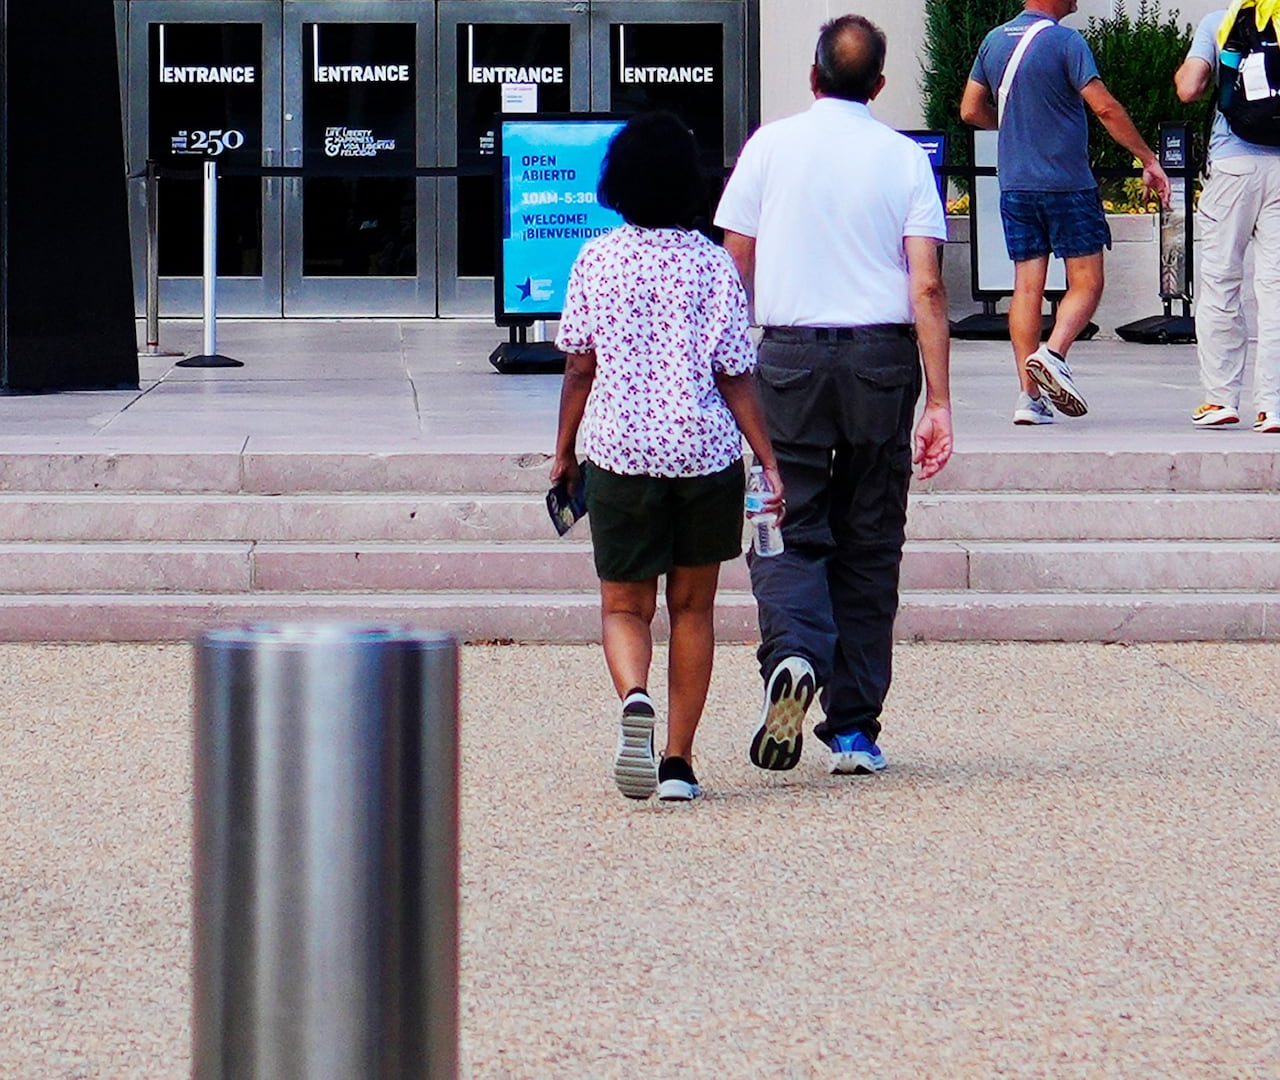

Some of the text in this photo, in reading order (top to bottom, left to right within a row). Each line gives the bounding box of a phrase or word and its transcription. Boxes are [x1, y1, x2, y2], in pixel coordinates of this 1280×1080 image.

[164, 67, 254, 83] ENTRANCE
[318, 65, 409, 82] ENTRANCE
[472, 67, 564, 83] ENTRANCE
[624, 67, 714, 83] ENTRANCE
[190, 129, 245, 156] 250
[521, 155, 556, 167] OPEN
[521, 169, 576, 181] ABIERTO
[522, 213, 588, 225] WELCOME!
